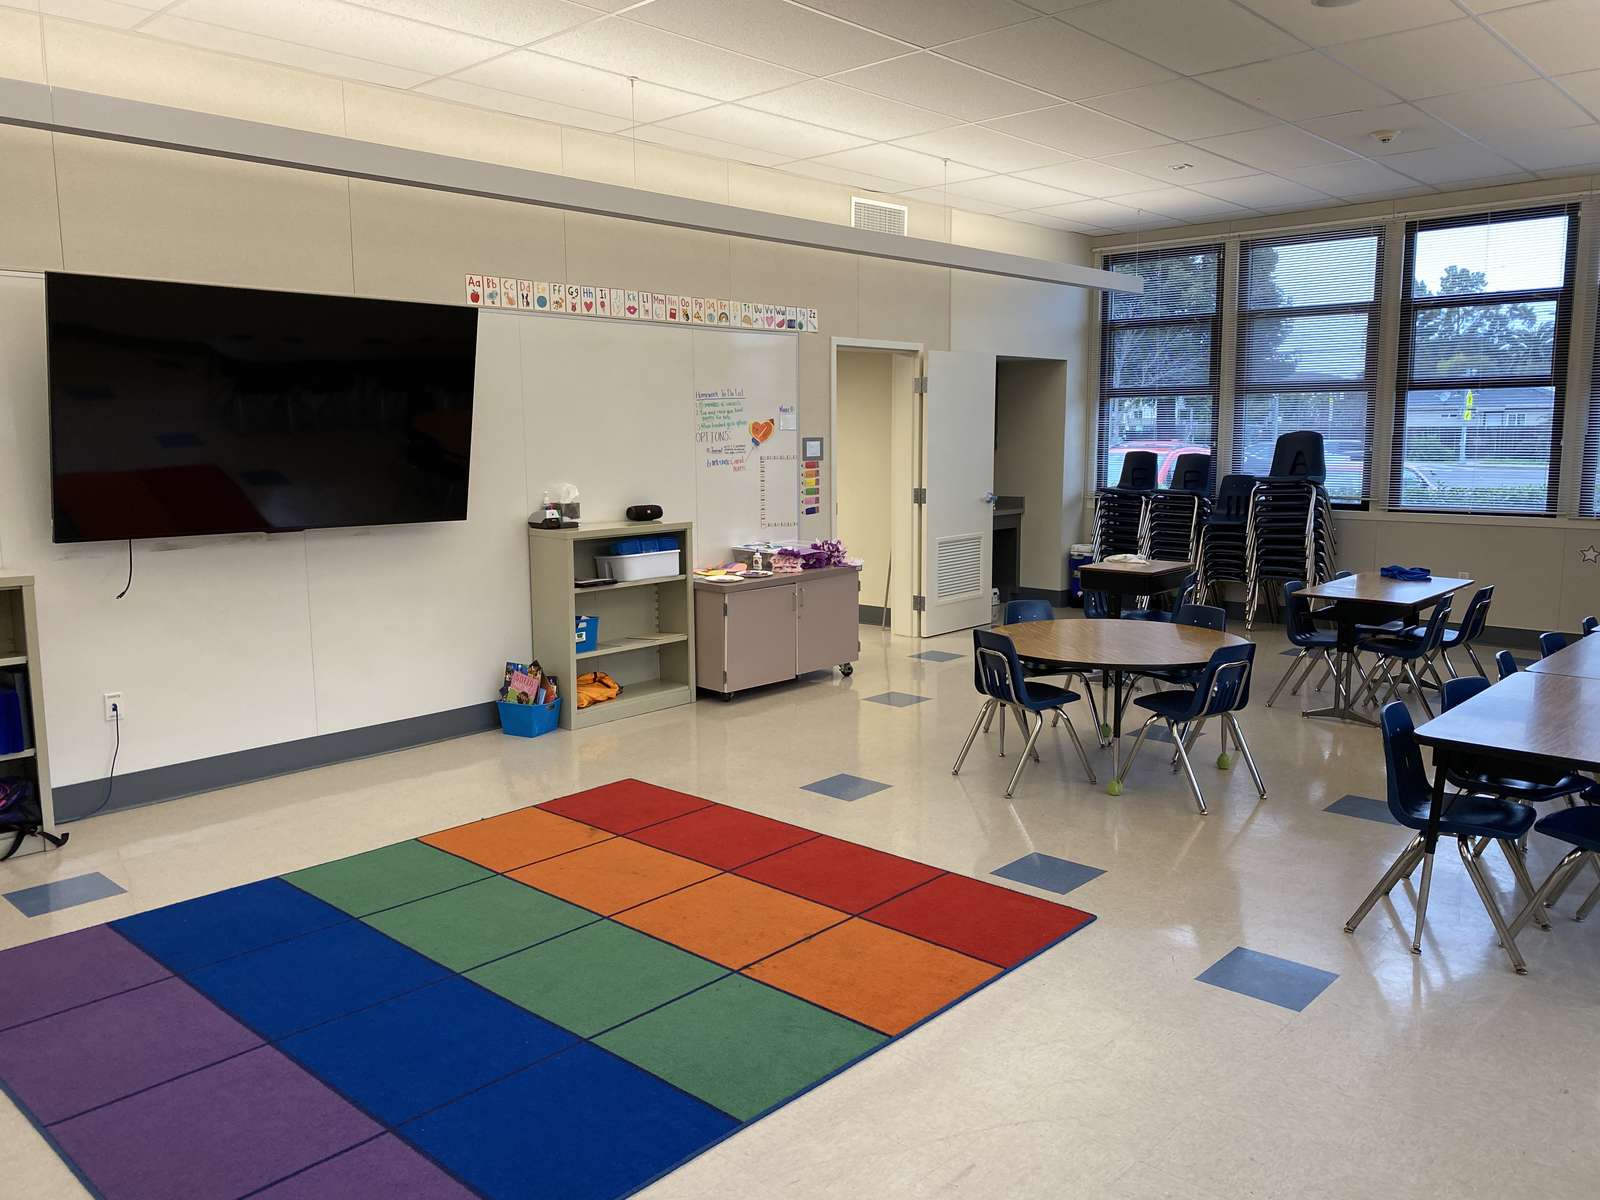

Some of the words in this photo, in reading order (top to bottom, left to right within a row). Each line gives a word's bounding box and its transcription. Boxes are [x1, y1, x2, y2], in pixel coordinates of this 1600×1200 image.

[468, 276, 481, 287] Aa
[486, 278, 497, 289] Bb
[503, 280, 513, 291] Cc
[520, 281, 531, 292] Dd
[553, 284, 562, 295] Ff
[568, 286, 579, 298] Gg
[582, 287, 593, 298] Hh
[599, 289, 607, 299] Ii
[627, 292, 637, 302] Kk
[642, 294, 649, 303] Ll
[653, 295, 664, 305] Mm
[681, 298, 690, 307] Oo
[694, 299, 703, 311] Pp
[764, 306, 773, 315] Vv
[775, 307, 786, 316] Ww
[808, 309, 816, 319] Zz
